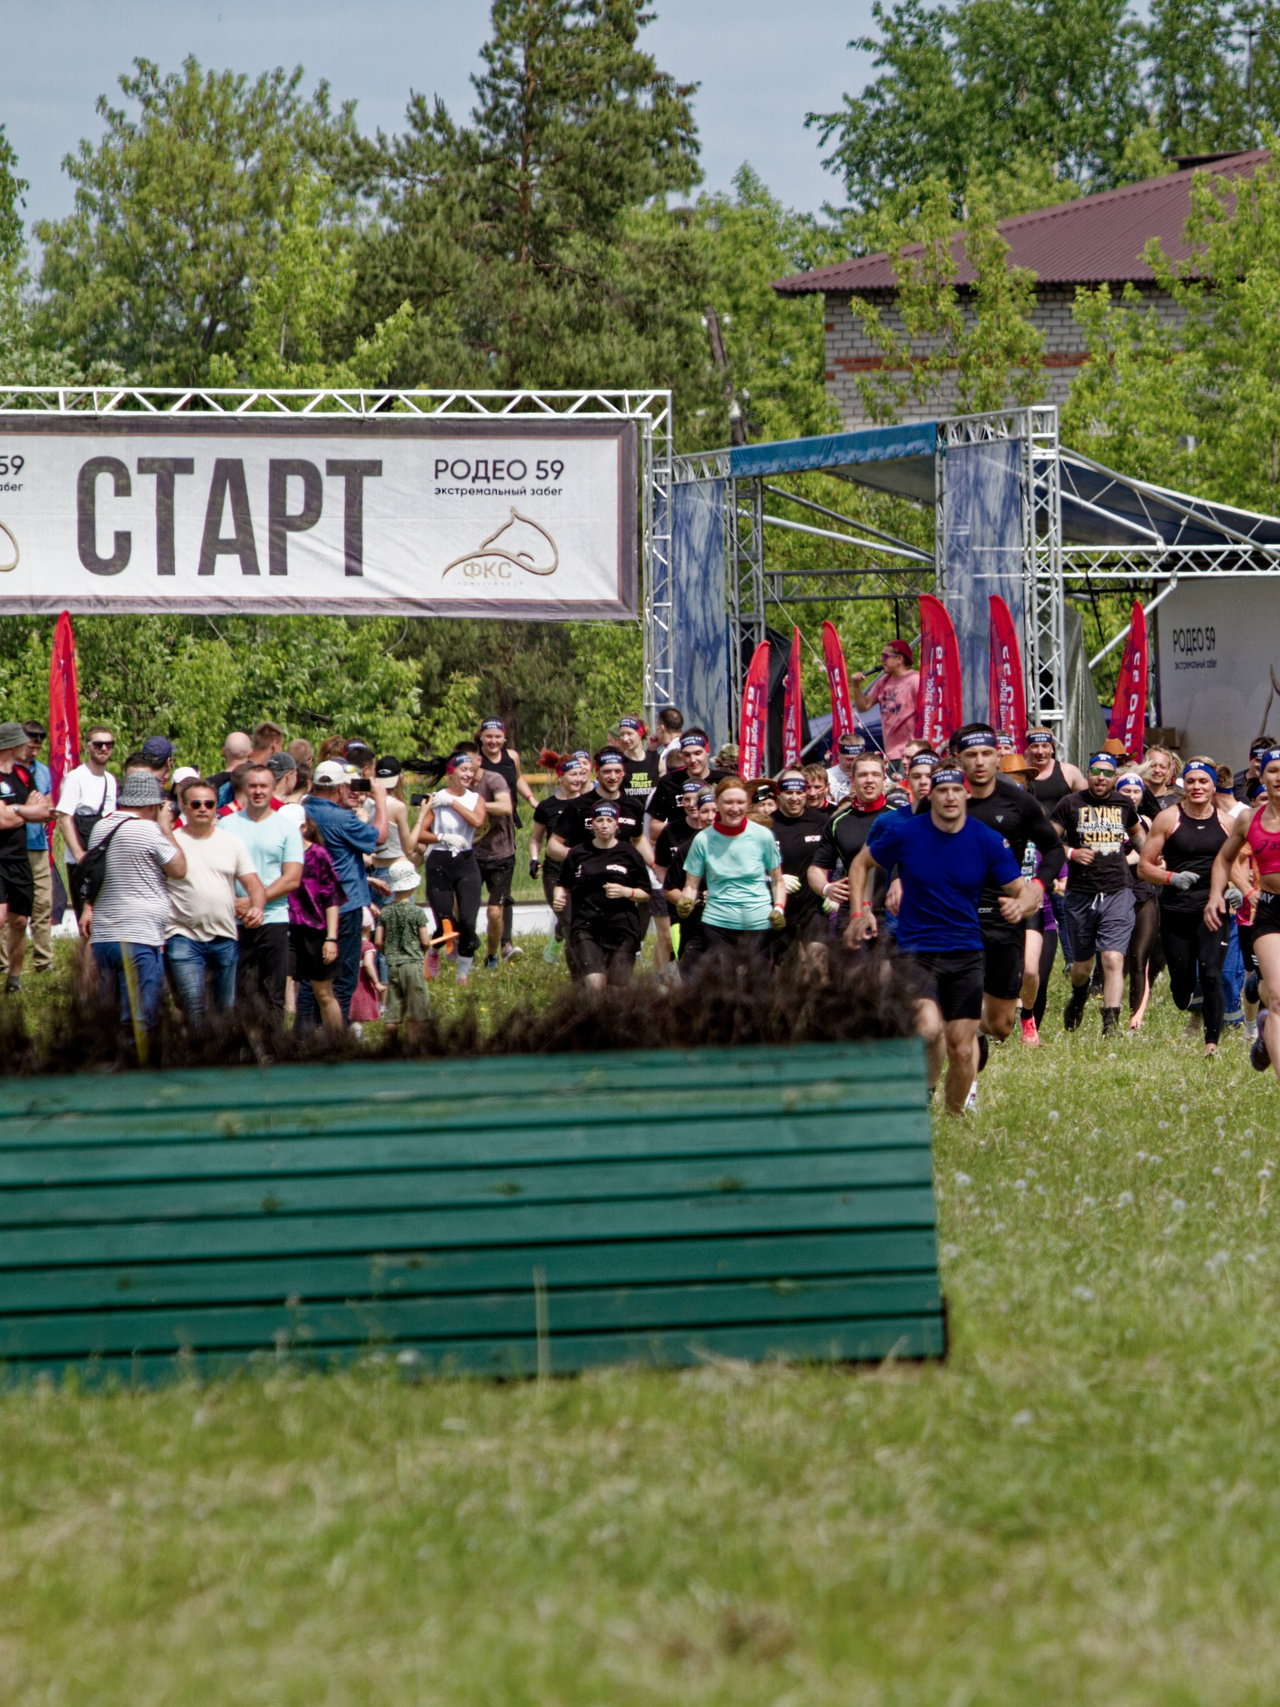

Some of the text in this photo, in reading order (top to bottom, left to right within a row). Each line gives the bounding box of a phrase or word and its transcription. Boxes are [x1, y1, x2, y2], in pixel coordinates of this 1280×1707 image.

[434, 459, 564, 483] РОДЕО 59
[0, 481, 23, 491] бег
[434, 486, 562, 496] экстремальный забег
[76, 455, 383, 577] СТАРТ
[462, 561, 512, 579] ФКС
[1172, 626, 1215, 656] РОДЕО 59
[632, 772, 648, 781] JUST
[630, 780, 652, 788] TRUST
